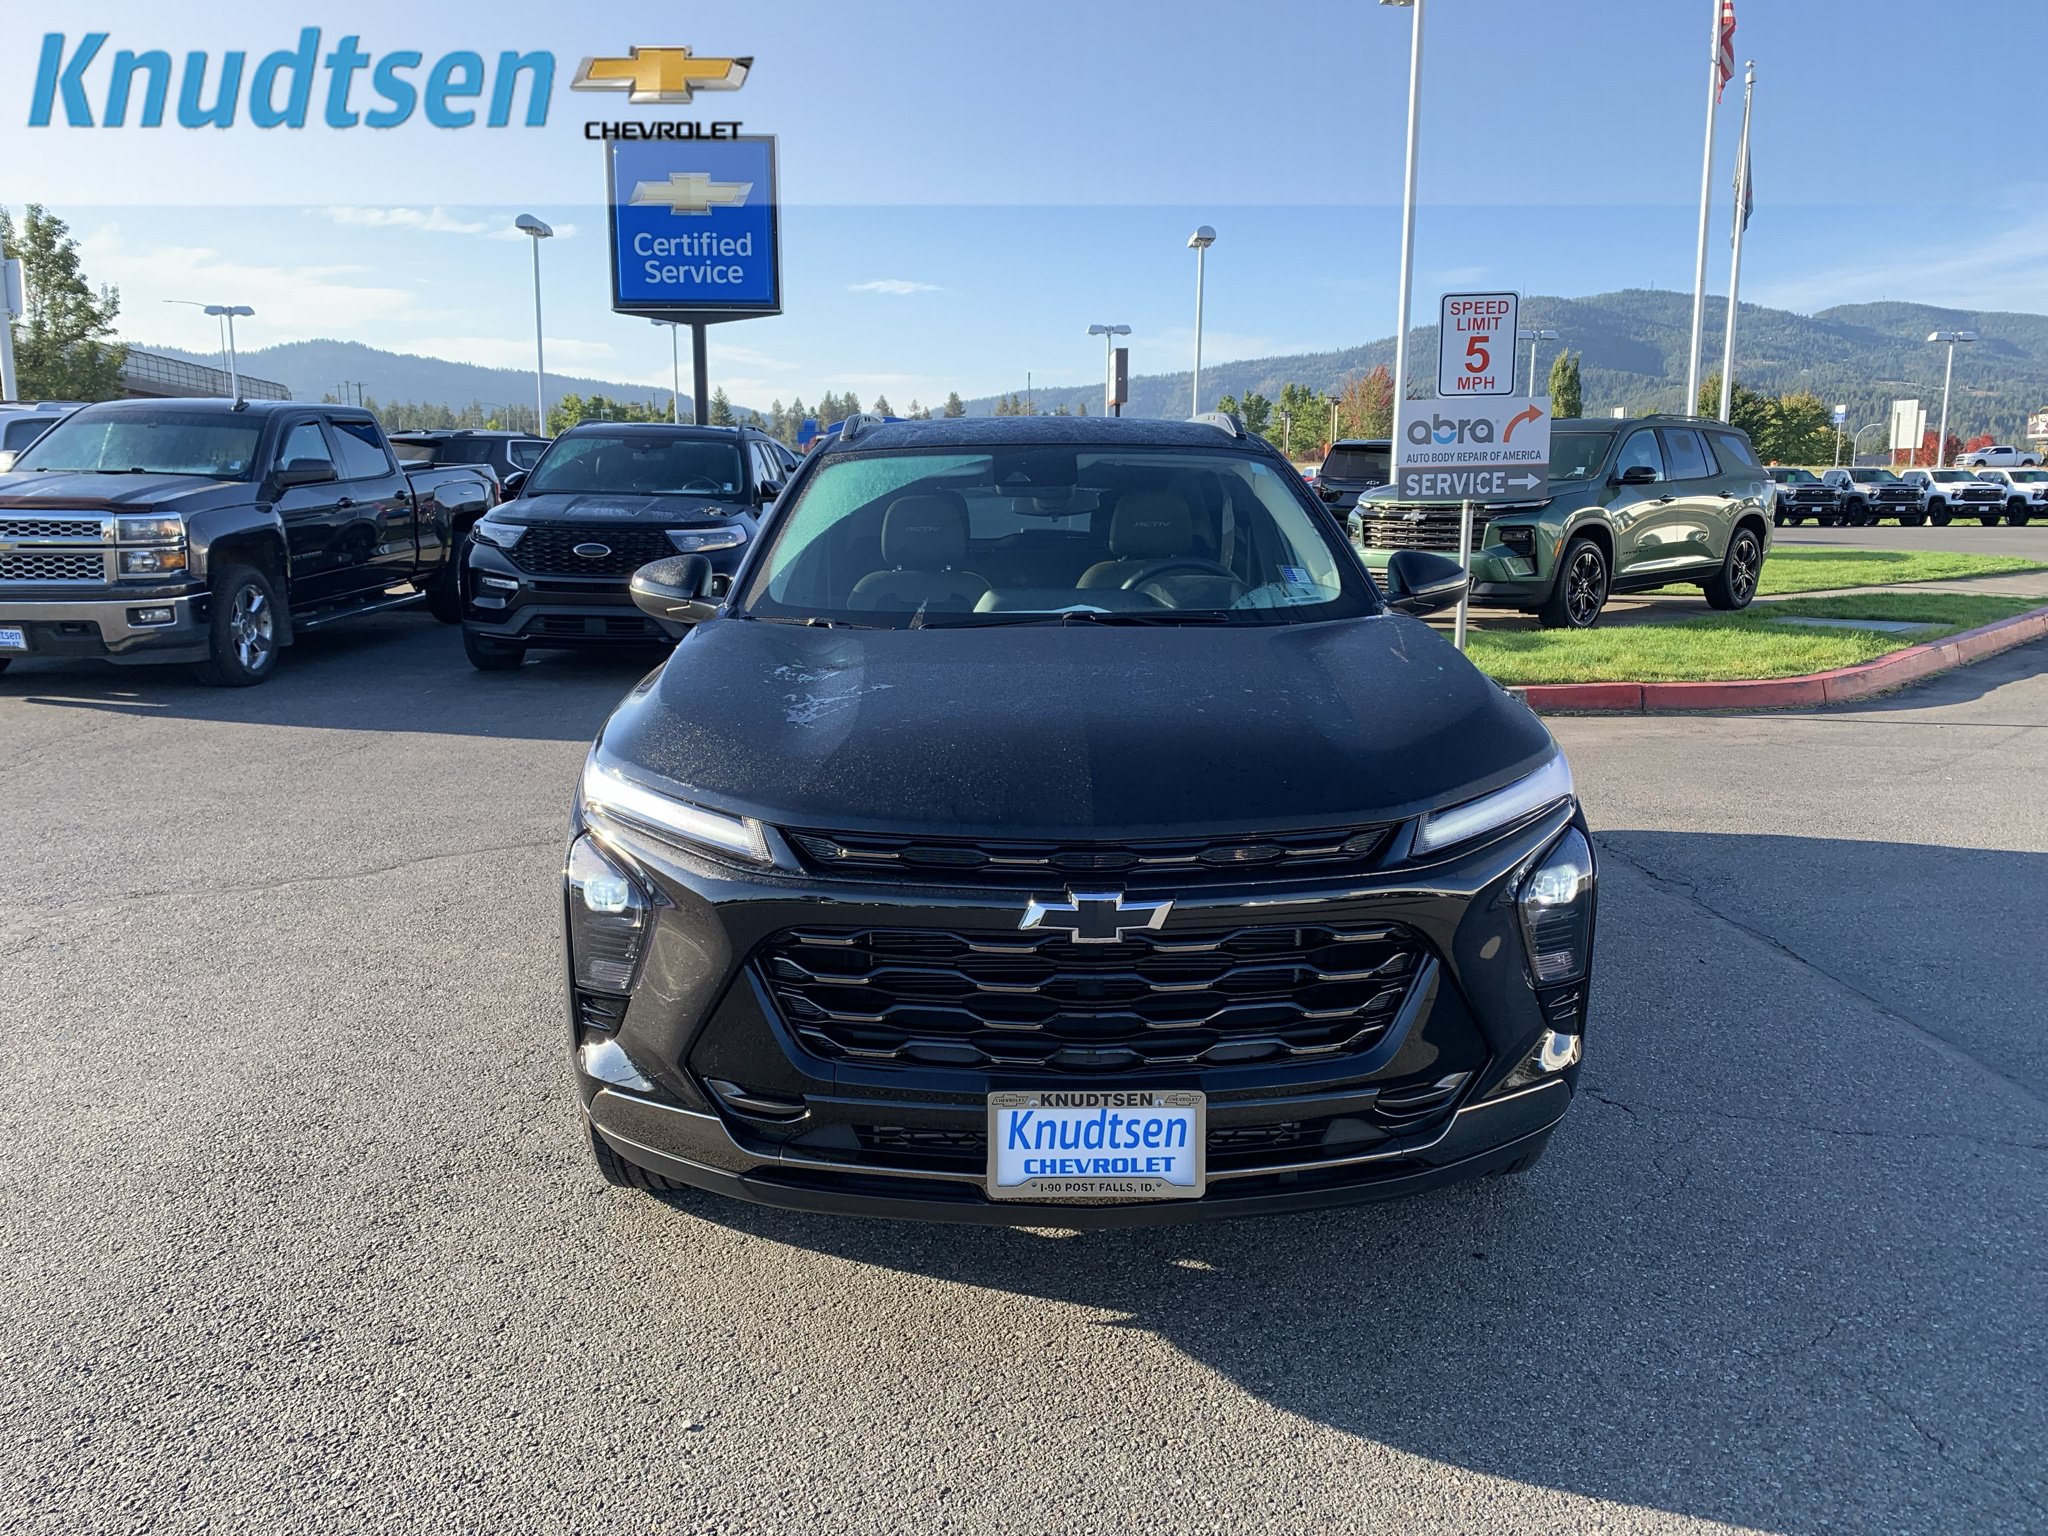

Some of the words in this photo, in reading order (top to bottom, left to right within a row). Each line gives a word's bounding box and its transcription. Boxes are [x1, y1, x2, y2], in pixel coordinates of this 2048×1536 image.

[633, 232, 752, 256] Certified
[644, 260, 744, 284] Service
[1450, 301, 1510, 316] SPEED
[1456, 316, 1502, 331] LIMIT
[1464, 335, 1490, 374] 5
[1457, 376, 1495, 390] MPH
[1406, 413, 1495, 446] abra
[1406, 453, 1430, 463] AUTO
[1431, 452, 1455, 463] BODY
[1456, 451, 1487, 462] REPAIR
[1489, 450, 1501, 461] OF
[1502, 449, 1542, 460] AMERICA
[1405, 471, 1506, 496] SERVICE
[1040, 1093, 1153, 1107] KNUDTSEN
[1008, 1108, 1188, 1150] Knudtsen
[1024, 1157, 1176, 1174] CHEVROLET
[1040, 1183, 1061, 1192] I-90
[1065, 1183, 1094, 1192] POST
[1099, 1183, 1137, 1193] FALLS,
[1140, 1182, 1156, 1192] ID.
